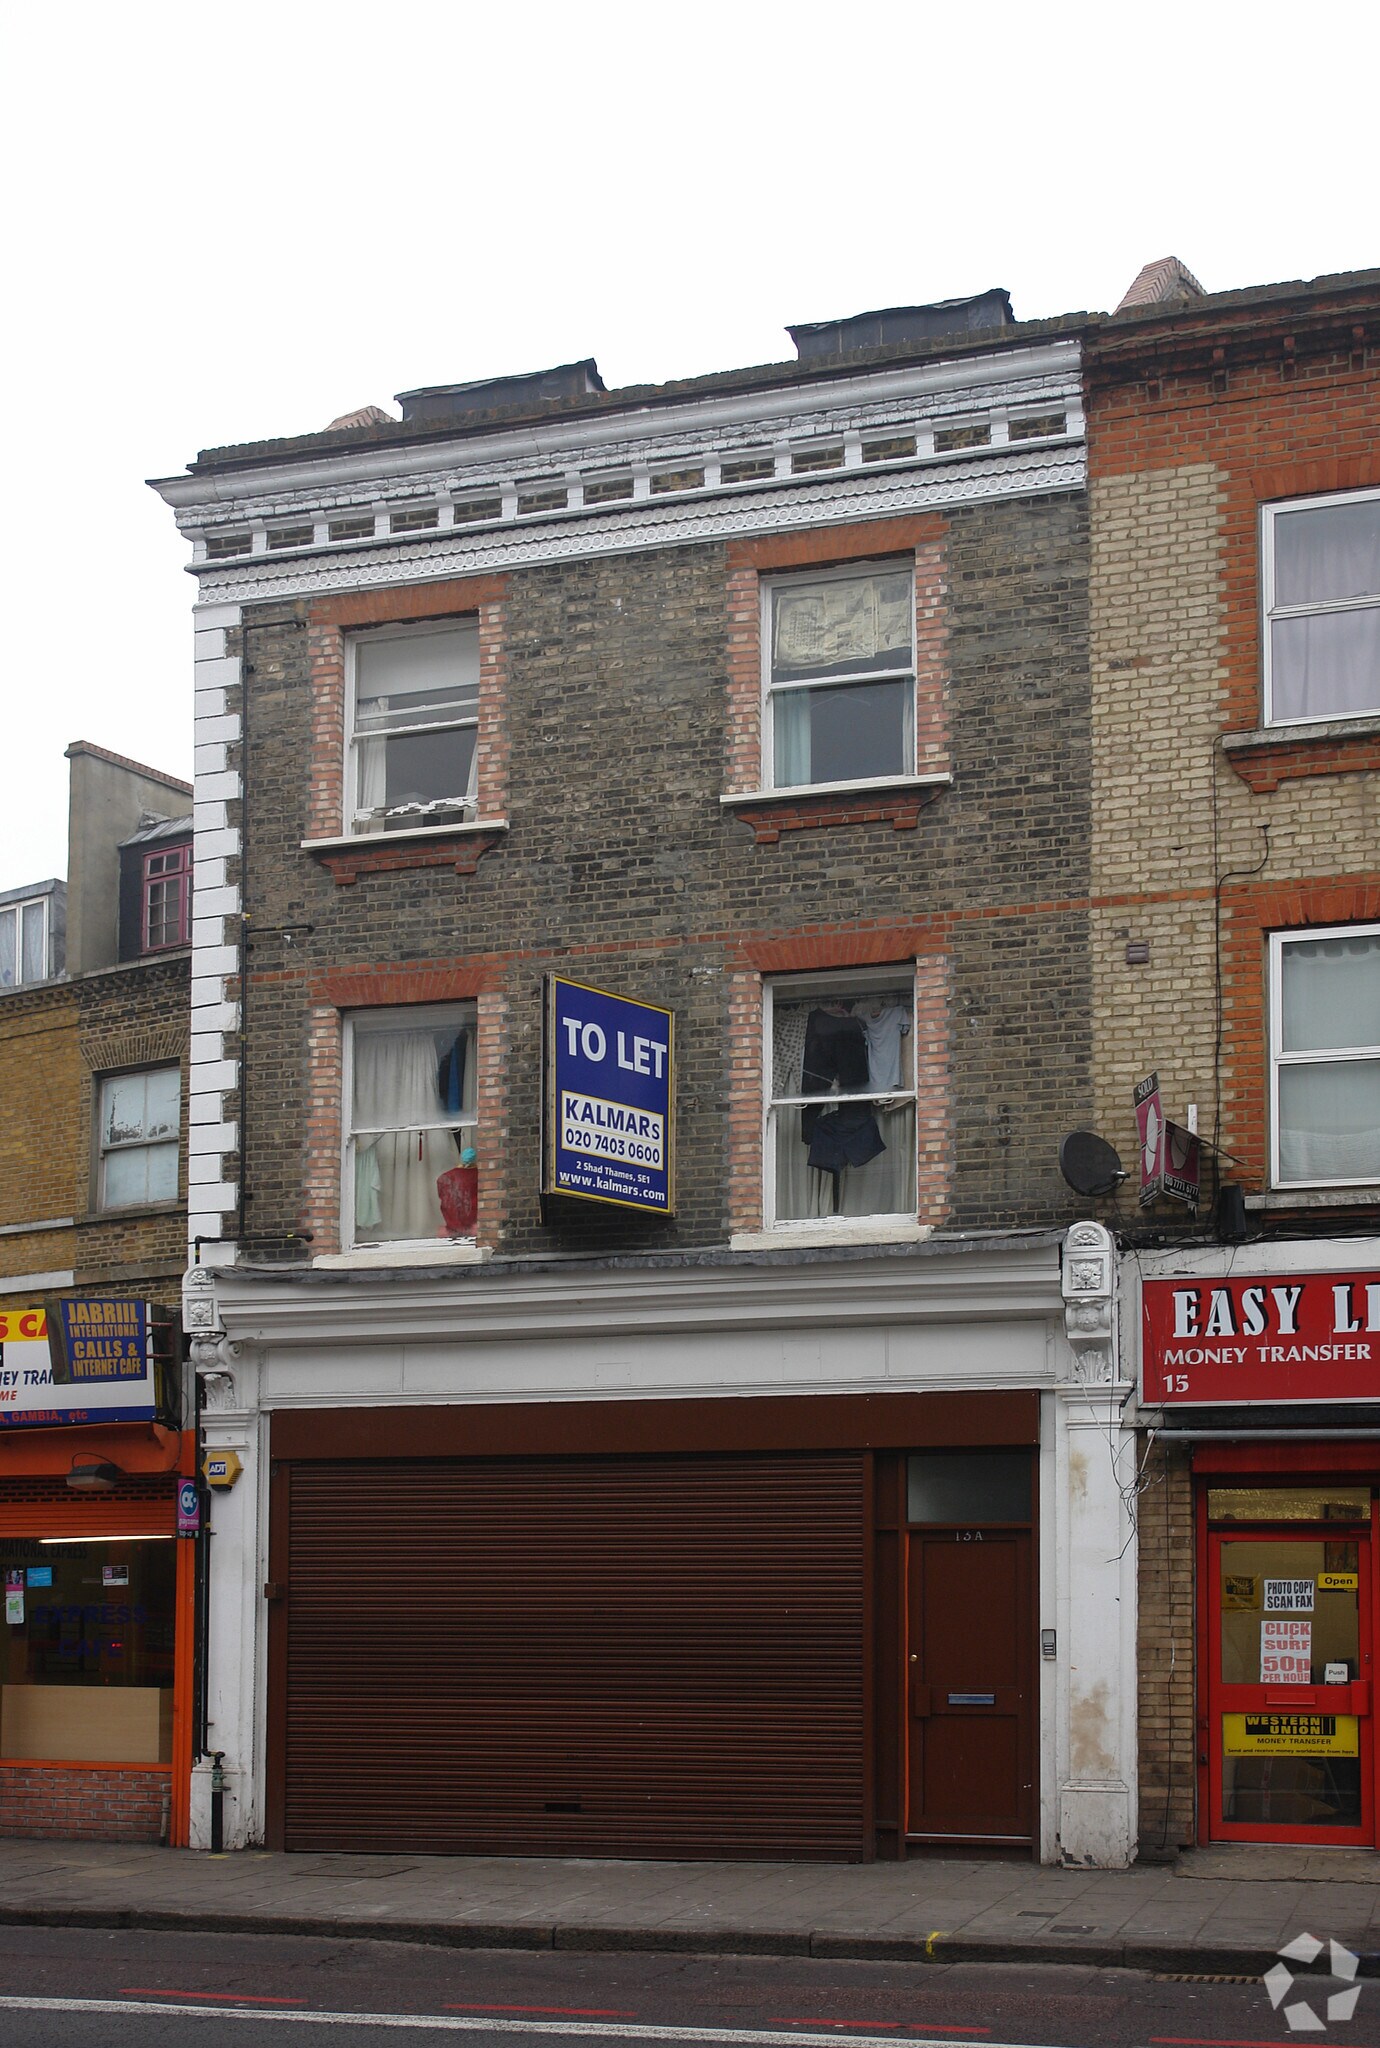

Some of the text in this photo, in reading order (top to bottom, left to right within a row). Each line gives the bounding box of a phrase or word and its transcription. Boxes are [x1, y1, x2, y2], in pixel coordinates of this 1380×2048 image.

[562, 1016, 667, 1079] TO LET
[1138, 1077, 1153, 1098] SOLD
[566, 1128, 660, 1164] 020 7403 0600
[576, 1161, 650, 1184] 2 Shad Thames, SE1
[559, 1171, 665, 1201] www.kalmars.com
[1172, 1284, 1303, 1338] EASY
[69, 1324, 139, 1338] INTERNATIONAL
[73, 1340, 138, 1359] CALLS &
[1164, 1343, 1372, 1365] MONEY TRANSFER
[72, 1357, 141, 1377] INTERNET CAFE
[0, 1370, 19, 1386] EY
[1162, 1374, 1190, 1393] 15
[68, 1409, 88, 1420] etc
[209, 1463, 226, 1473] ADT
[1267, 1582, 1292, 1595] PHOTO
[1293, 1581, 1314, 1594] COPY
[1325, 1576, 1353, 1586] Open
[1267, 1595, 1313, 1609] SCAN FAX
[1265, 1622, 1310, 1636] CLICK
[1264, 1640, 1310, 1650] SURF
[1263, 1655, 1310, 1672] 50p
[1262, 1672, 1310, 1682] PER HOUR
[1246, 1716, 1321, 1726] WESTERN
[1269, 1725, 1321, 1735] UNION
